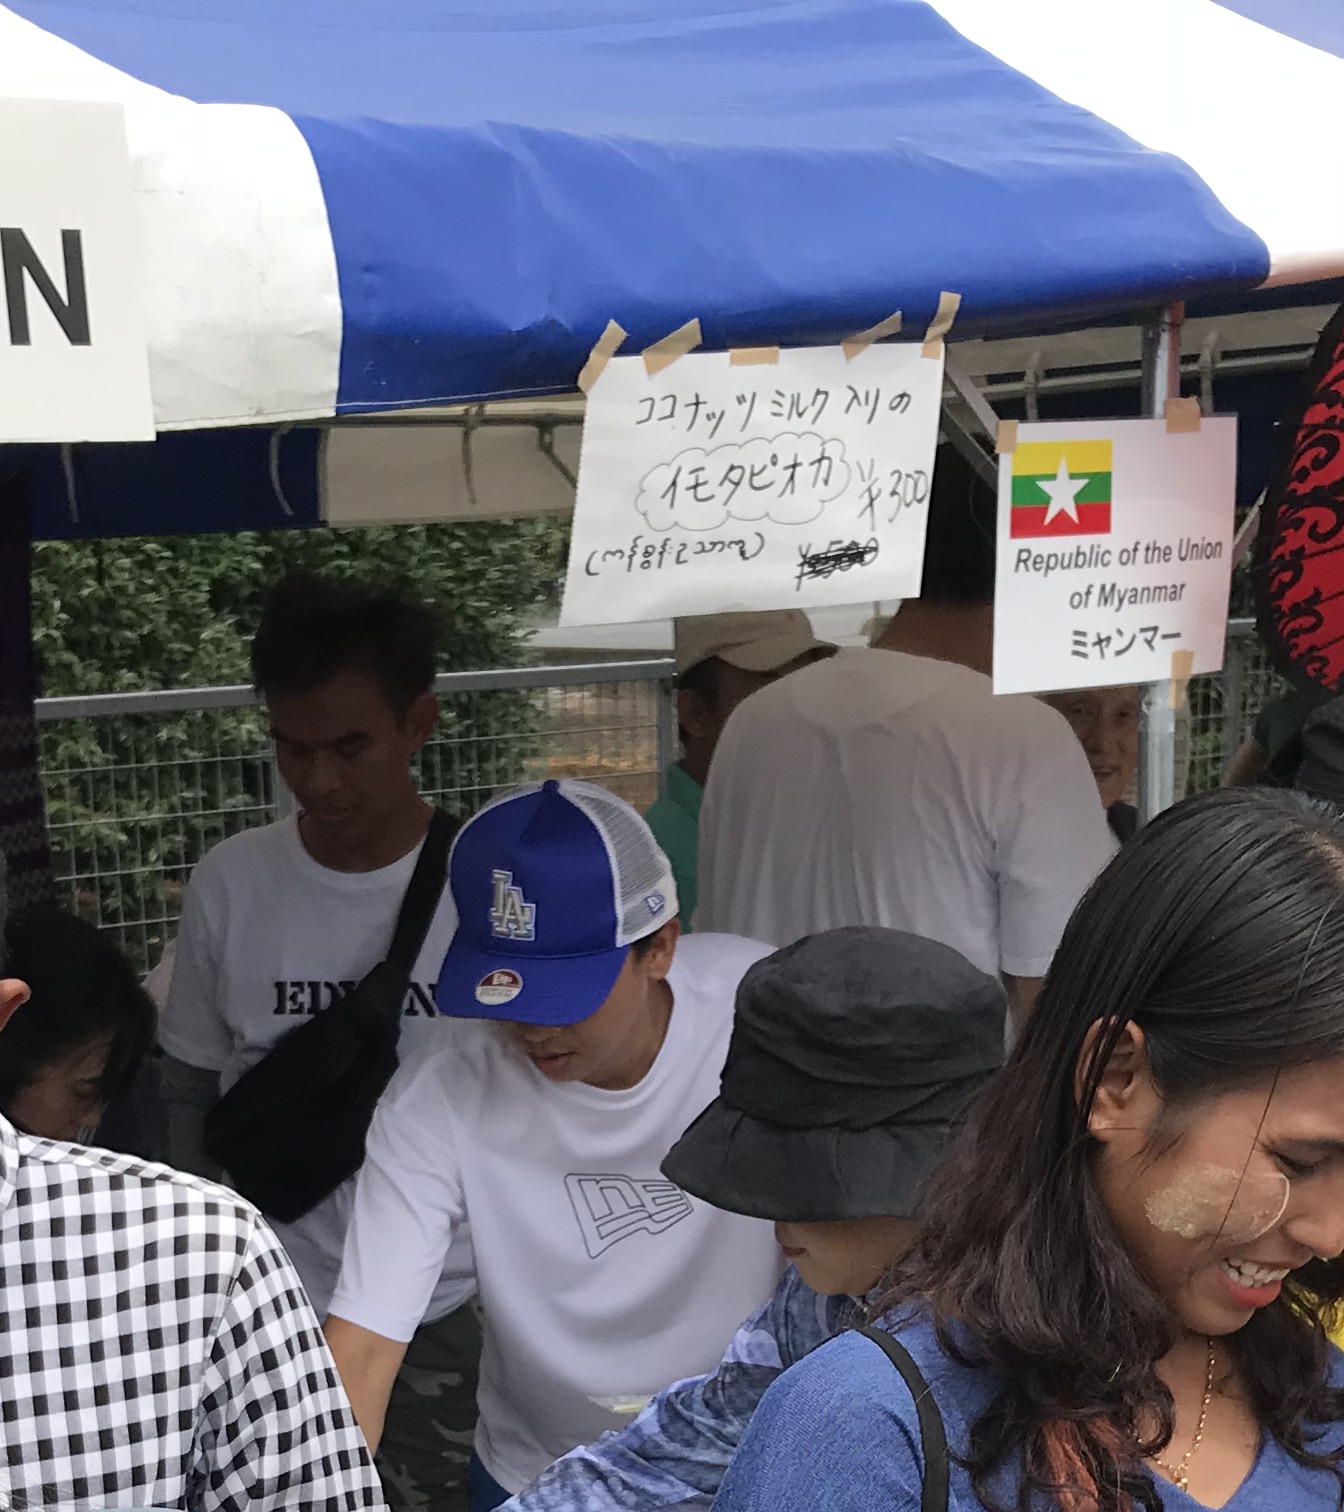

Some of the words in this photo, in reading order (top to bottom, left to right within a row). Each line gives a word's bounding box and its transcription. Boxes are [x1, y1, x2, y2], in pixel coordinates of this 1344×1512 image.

[635, 384, 912, 439] ココナッツミルク入りの
[660, 447, 835, 510] イモタピオカ
[1014, 543, 1113, 578] Republic
[1118, 541, 1139, 567] of
[1144, 540, 1172, 564] the
[1178, 536, 1223, 562] Union
[1069, 583, 1093, 610] of
[1097, 581, 1186, 612] Myanmar
[1070, 625, 1182, 660] ミャンマー
[489, 869, 536, 941] LA
